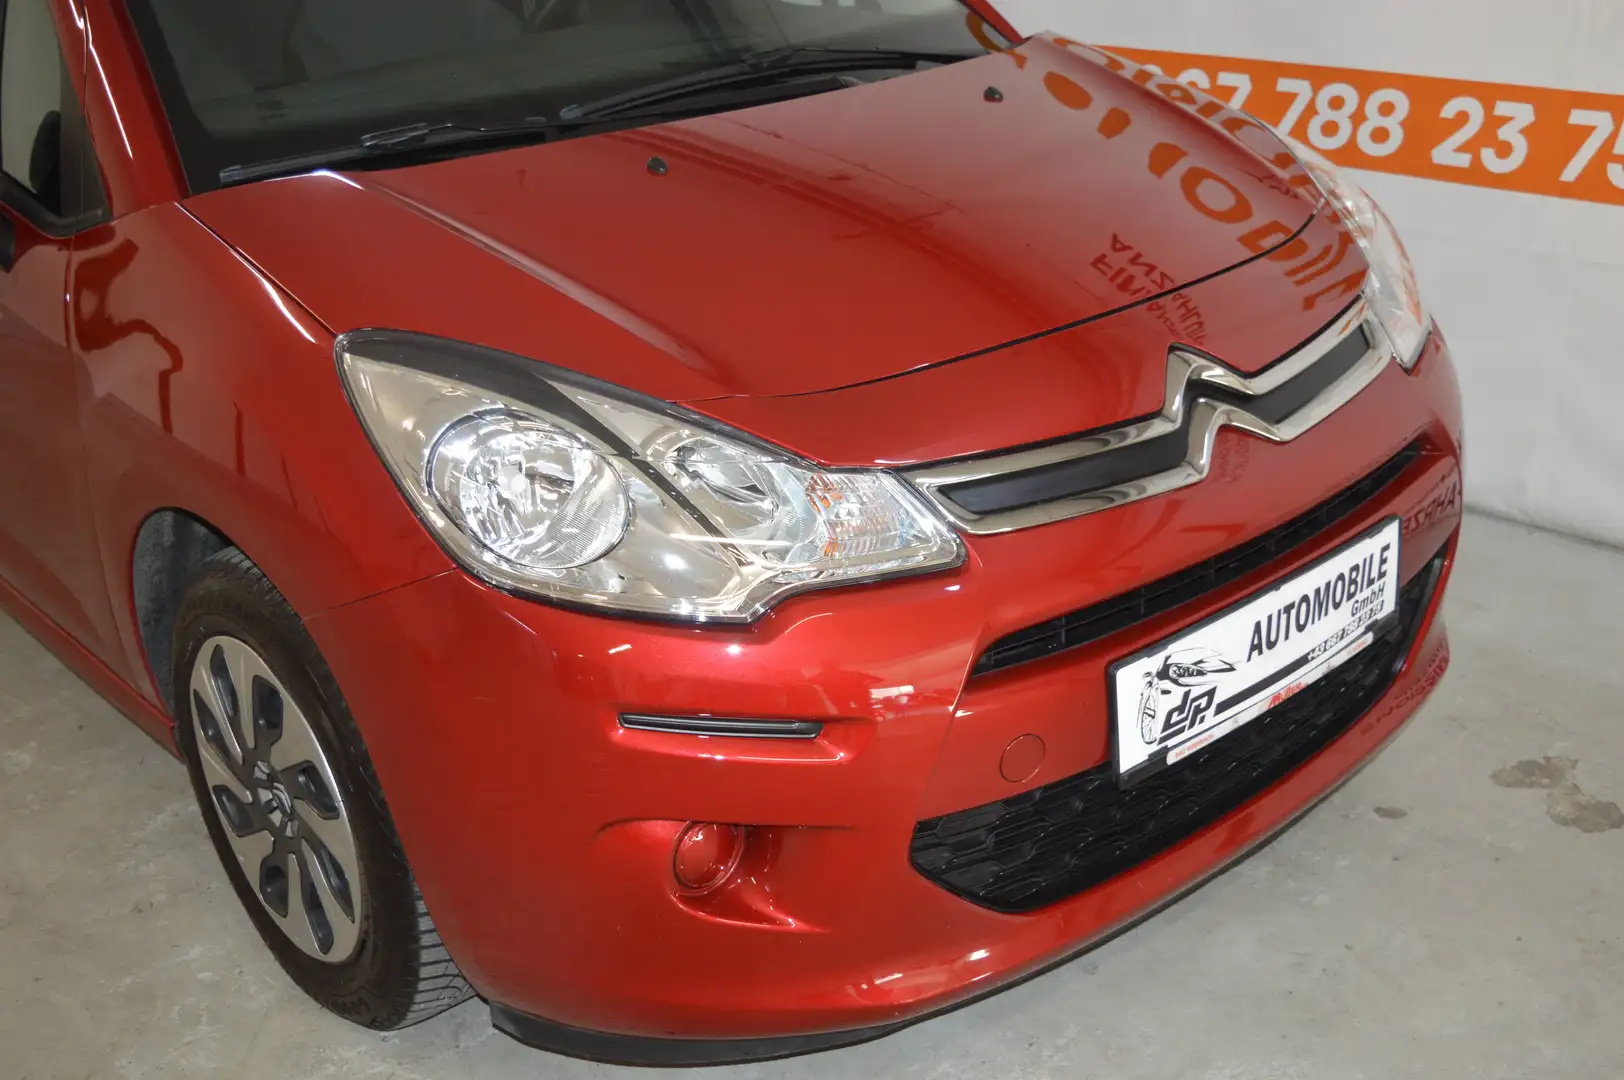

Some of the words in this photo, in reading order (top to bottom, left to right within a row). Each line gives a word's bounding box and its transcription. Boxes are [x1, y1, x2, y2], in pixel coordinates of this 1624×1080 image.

[1274, 77, 1409, 157] 788
[1431, 96, 1536, 174] 23
[1246, 542, 1391, 663] AUTOMOBILE
[1351, 581, 1386, 617] GmbH
